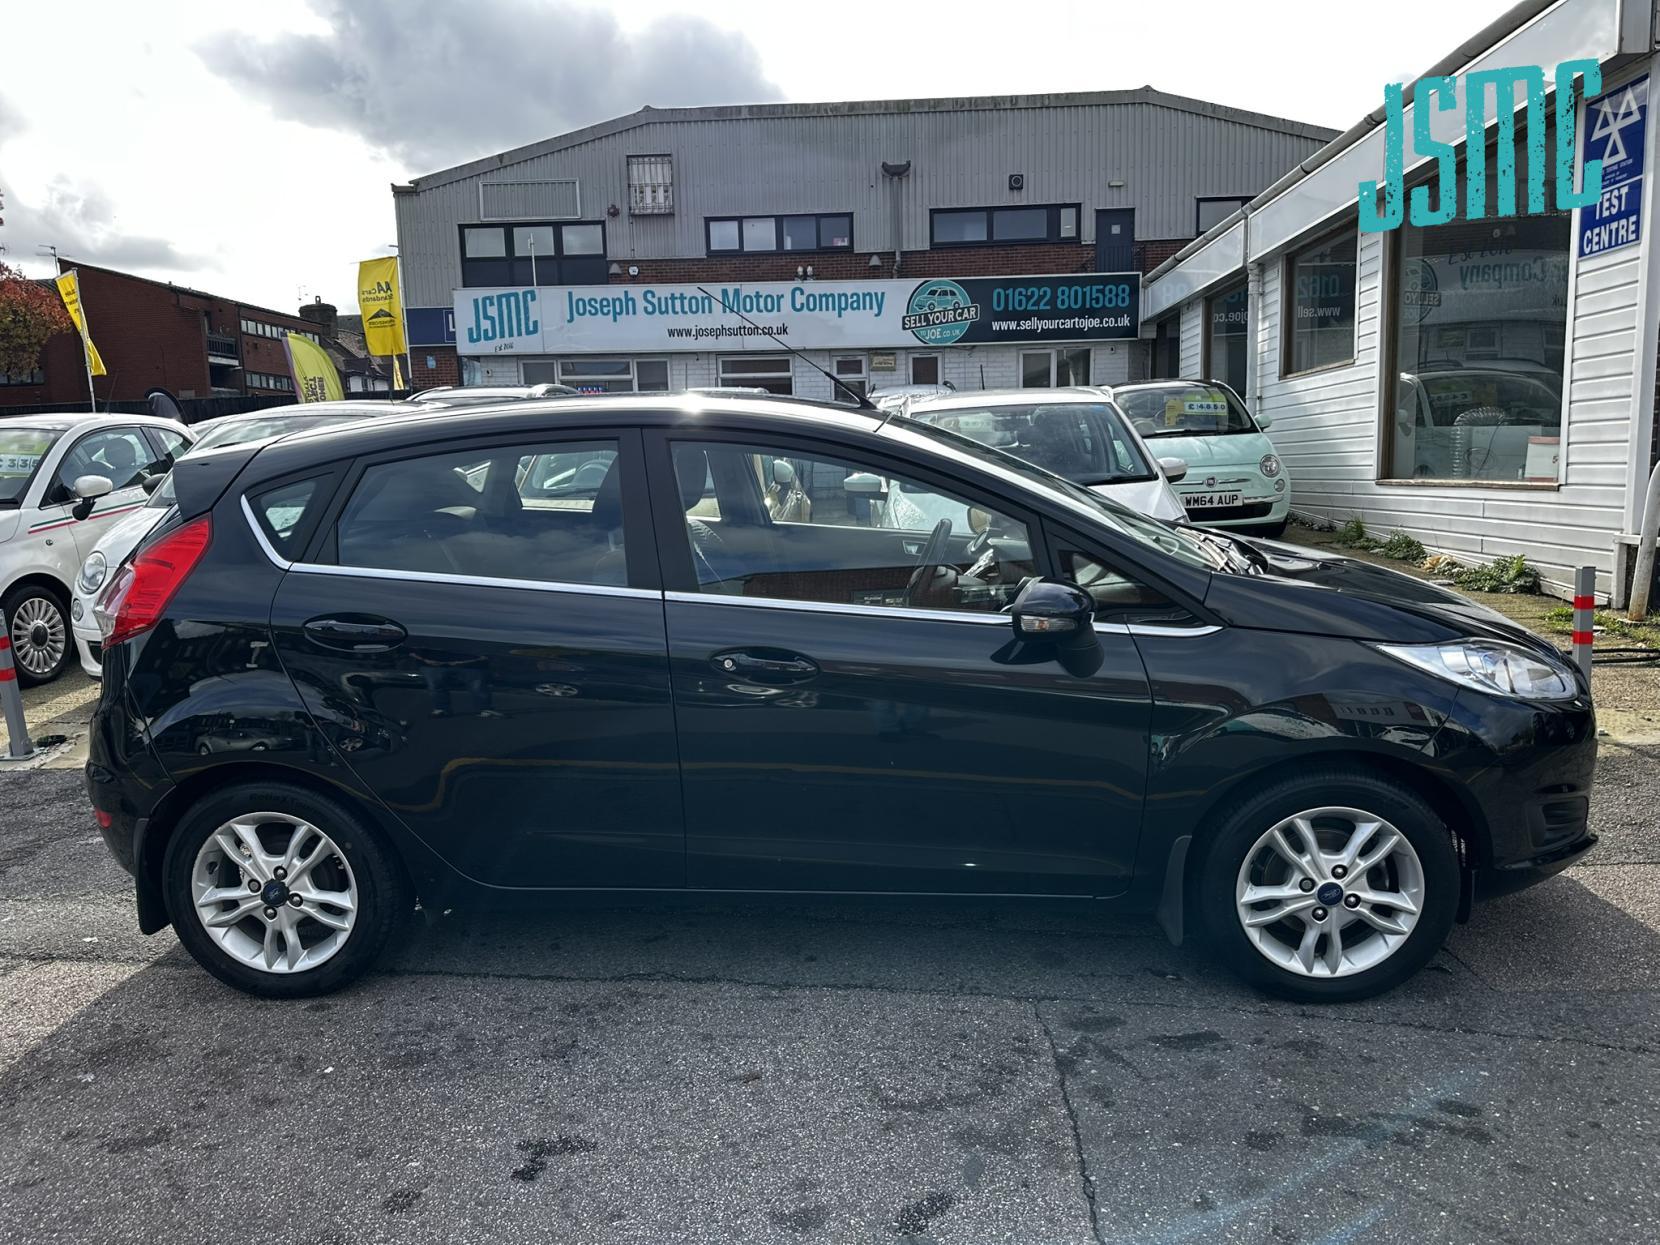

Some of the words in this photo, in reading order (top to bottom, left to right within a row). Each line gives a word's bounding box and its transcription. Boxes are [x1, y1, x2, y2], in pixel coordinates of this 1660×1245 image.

[1596, 185, 1628, 220] TEST
[1583, 214, 1638, 255] CENTRE
[567, 290, 637, 323] Joseph
[643, 289, 712, 315] Sutton
[721, 288, 784, 314] Motor
[790, 286, 885, 318] Company
[992, 287, 1051, 311] 01622
[1056, 284, 1130, 309] 801588
[467, 290, 539, 343] JSMC
[904, 314, 927, 329] SELL
[928, 310, 955, 325] YOUR
[955, 307, 976, 321] CAR
[991, 313, 1130, 333] www.sellyourcartojoe.co.uk
[667, 323, 788, 340] www.josephsutton.co.uk
[1185, 495, 1214, 507] WM64
[1217, 494, 1238, 506] AUP
